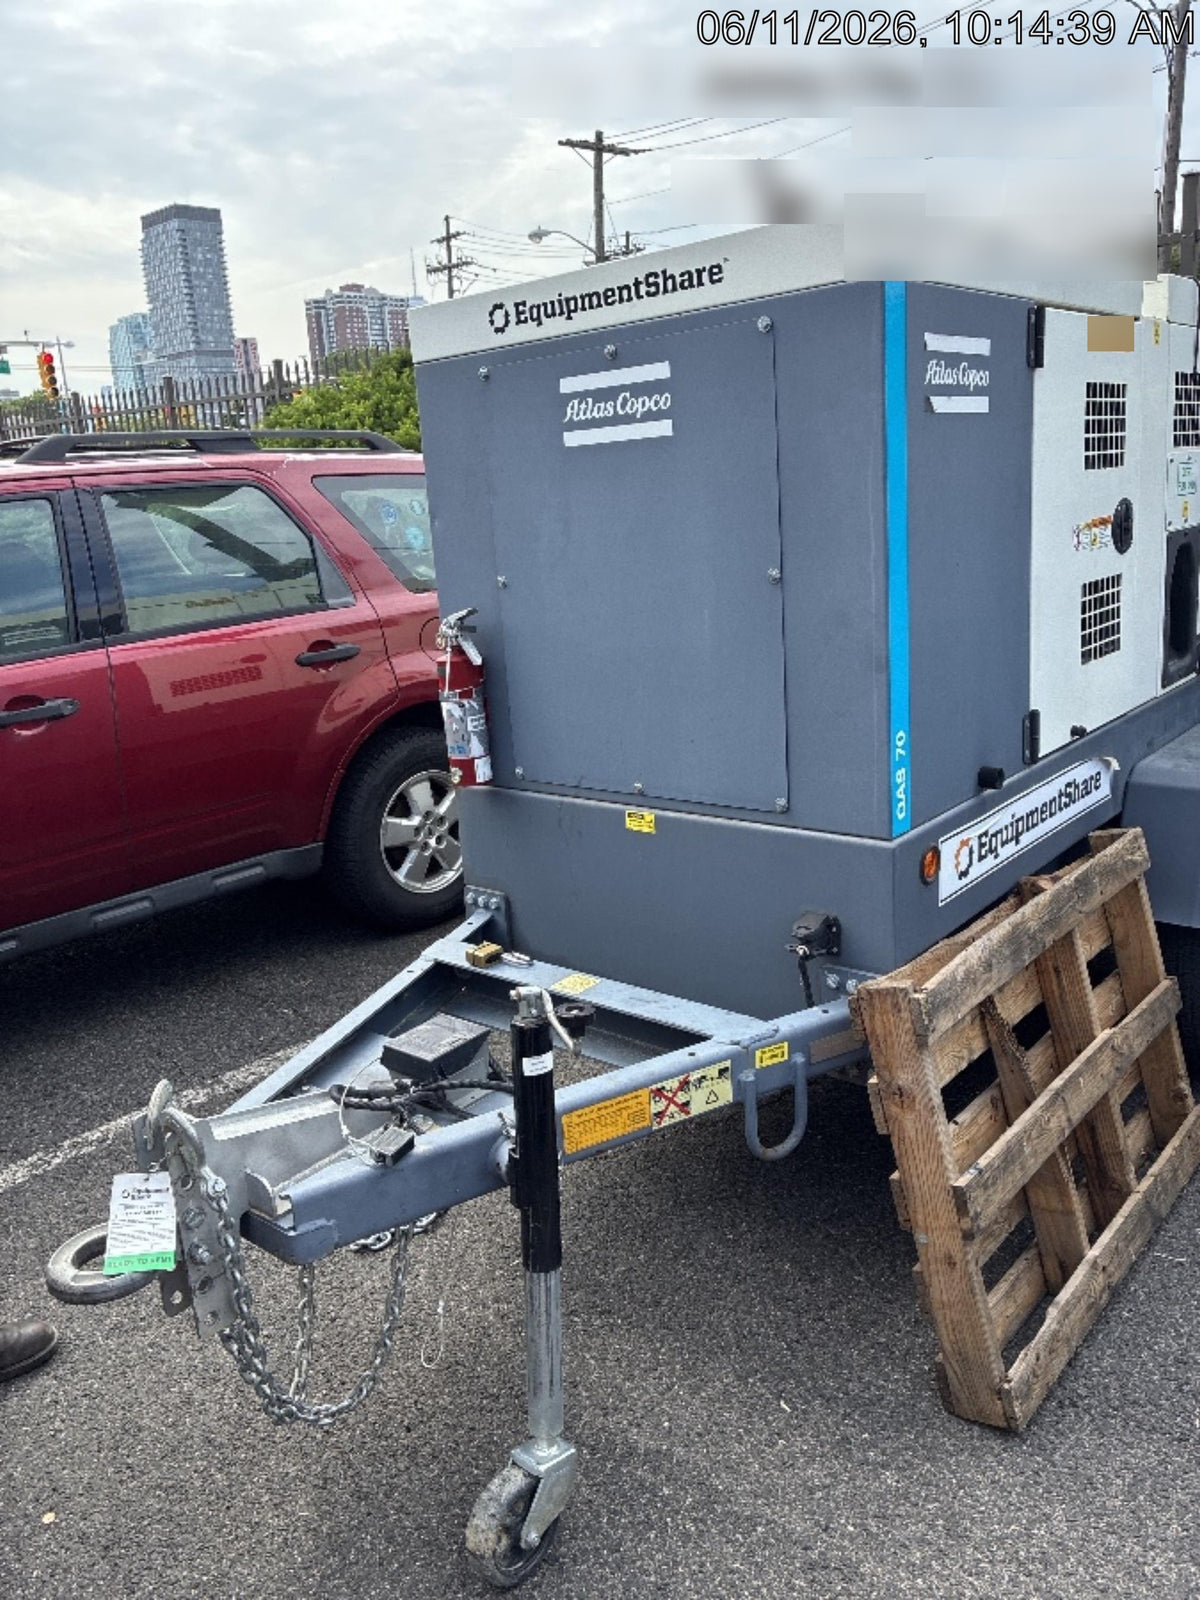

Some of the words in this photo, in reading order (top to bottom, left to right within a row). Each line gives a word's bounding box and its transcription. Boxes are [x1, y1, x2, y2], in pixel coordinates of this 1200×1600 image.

[514, 262, 725, 327] EquipmentShare
[924, 359, 957, 385] Atlas
[959, 361, 989, 391] Copco
[563, 398, 614, 423] Atlas
[616, 391, 672, 418] Copco
[895, 730, 907, 761] 70
[896, 767, 907, 821] QAS
[977, 770, 1102, 863] EquipmentShare
